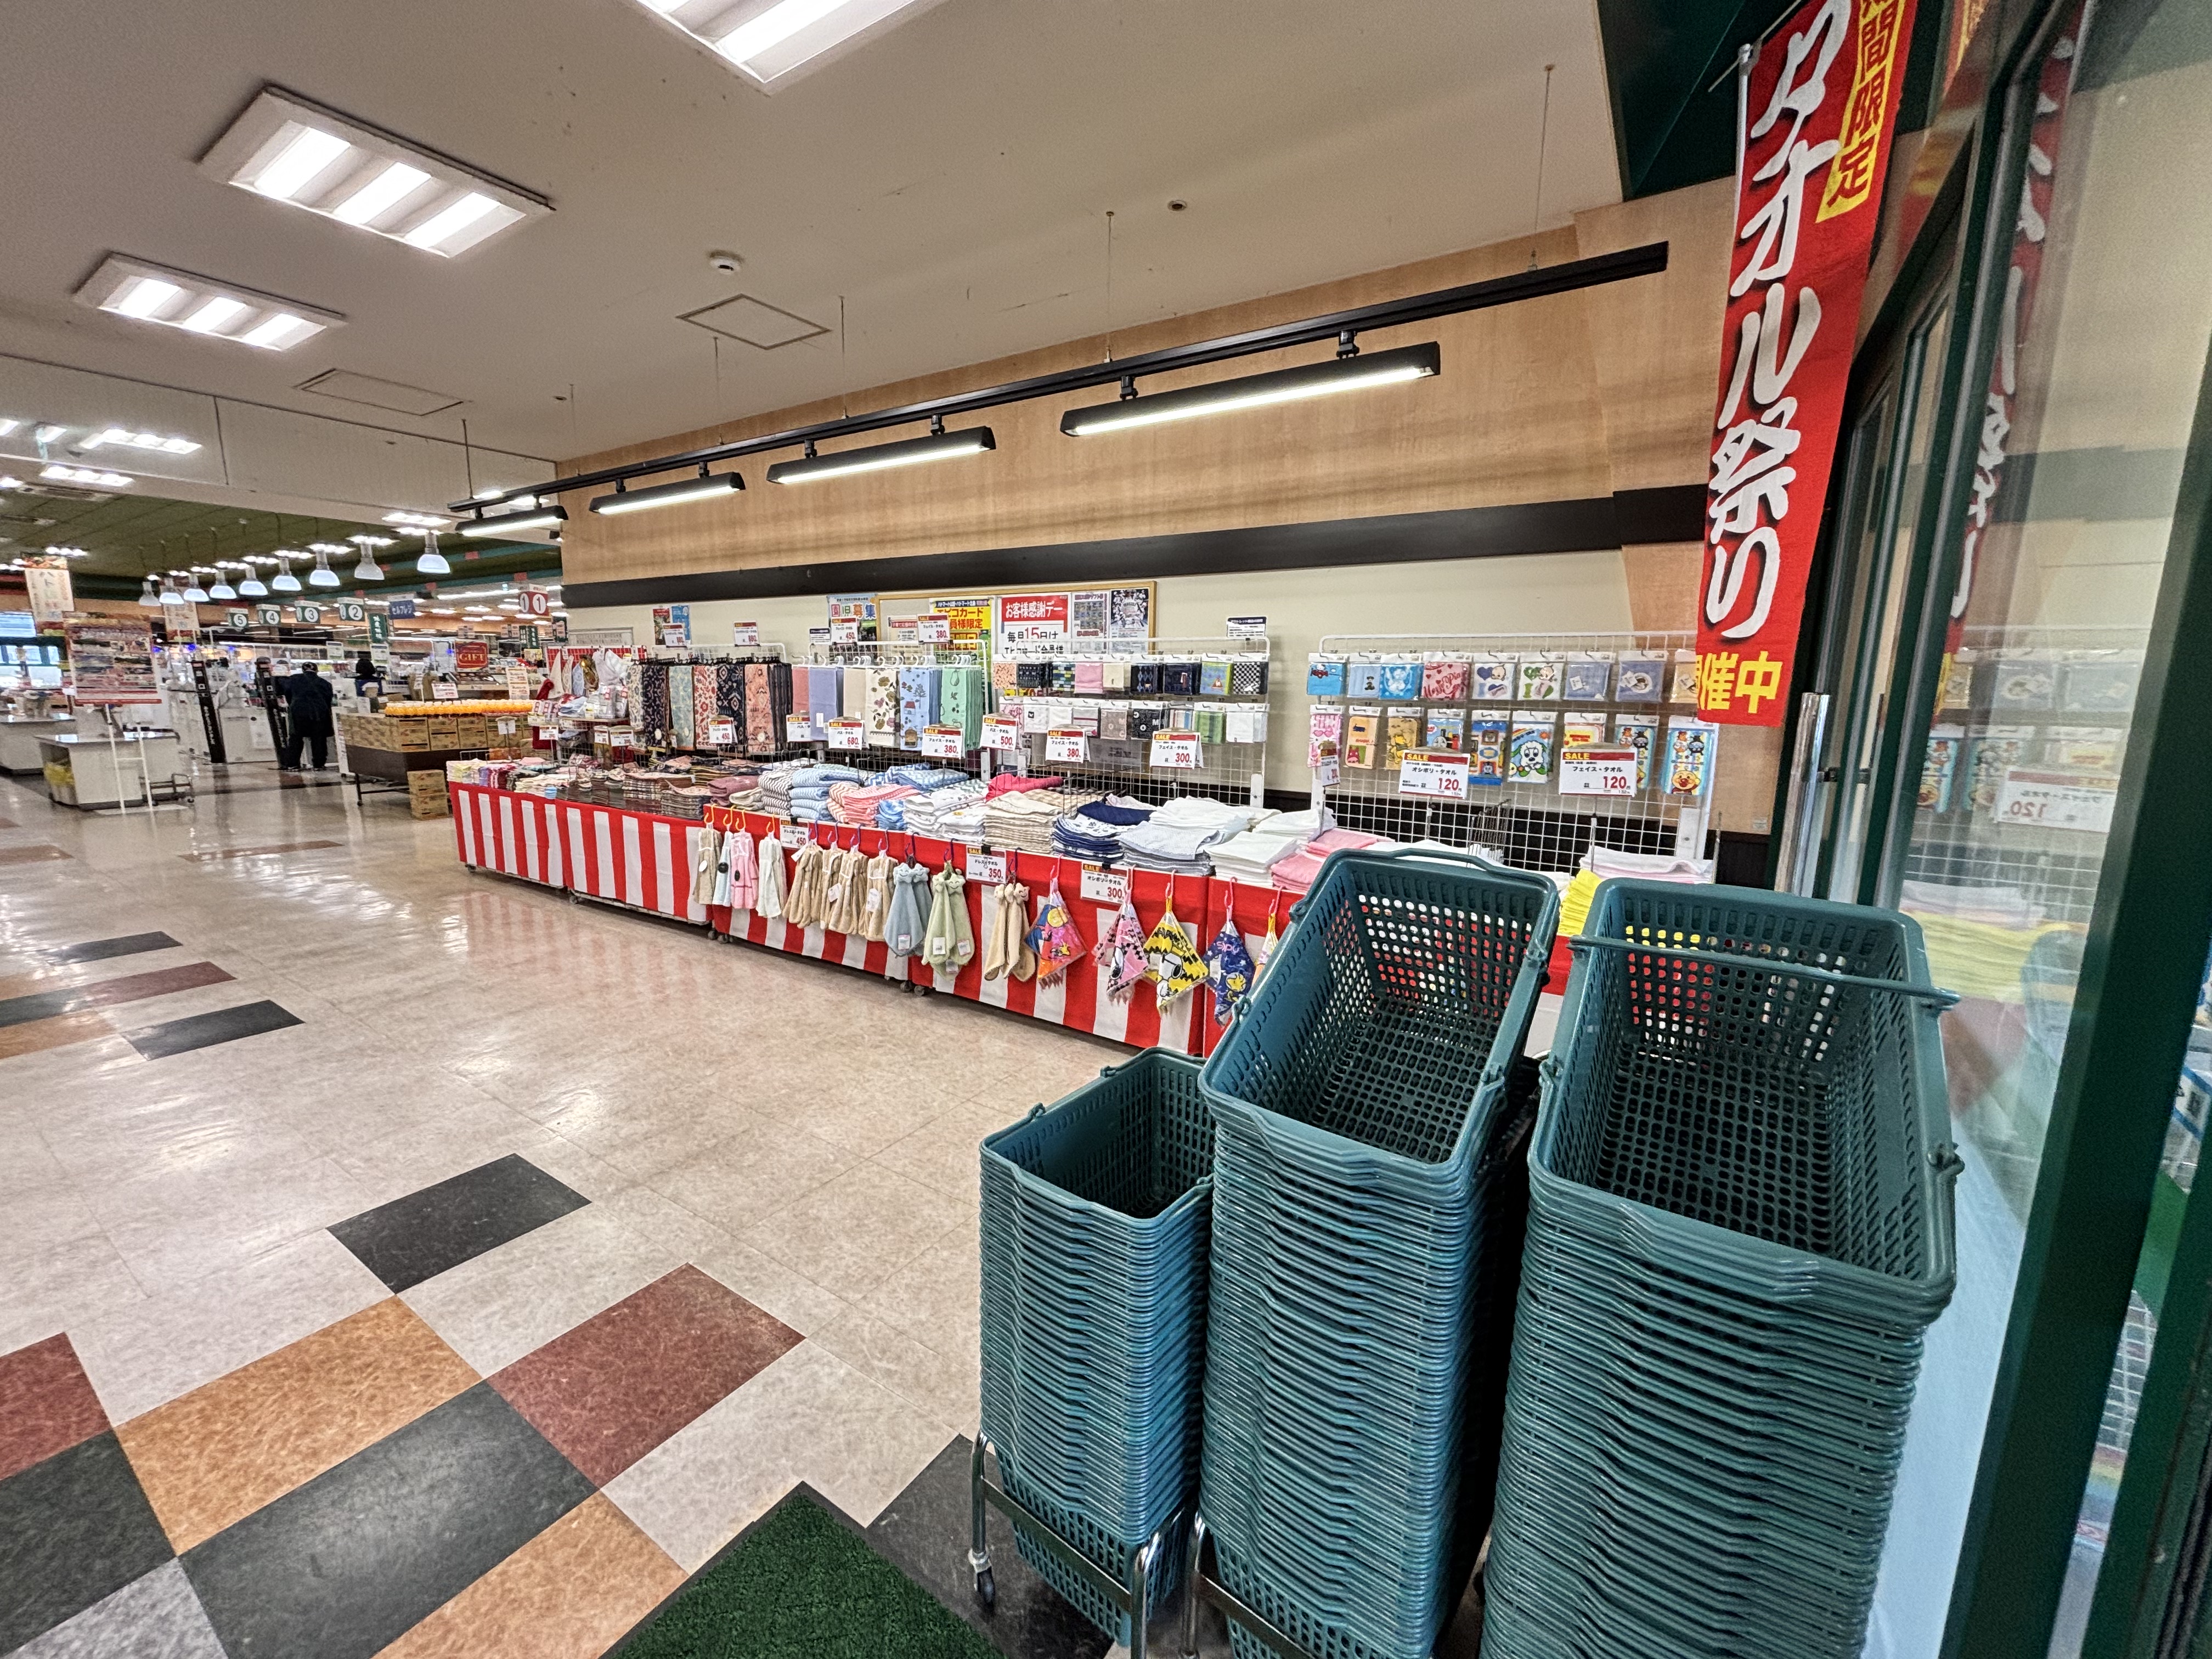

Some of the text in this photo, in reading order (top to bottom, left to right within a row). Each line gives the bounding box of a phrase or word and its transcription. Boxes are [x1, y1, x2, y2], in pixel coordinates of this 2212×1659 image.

[1827, 0, 1903, 208] 間限定
[1705, 0, 1852, 637] タオル祭り
[353, 606, 359, 618] 2
[1006, 600, 1063, 618] お客様感謝デー
[269, 612, 275, 622] 4
[309, 610, 315, 619] 3
[238, 616, 244, 624] 5
[459, 653, 484, 662] GIFT
[1001, 736, 1012, 746] 500
[944, 744, 957, 753] 380
[1066, 748, 1079, 758] 380
[1407, 753, 1429, 761] SALE
[1412, 766, 1457, 775] オシボリ・タオル
[797, 837, 806, 845] 450
[989, 868, 1002, 879] 350
[1087, 876, 1121, 885] オシボリタオル
[1107, 887, 1122, 899] 300
